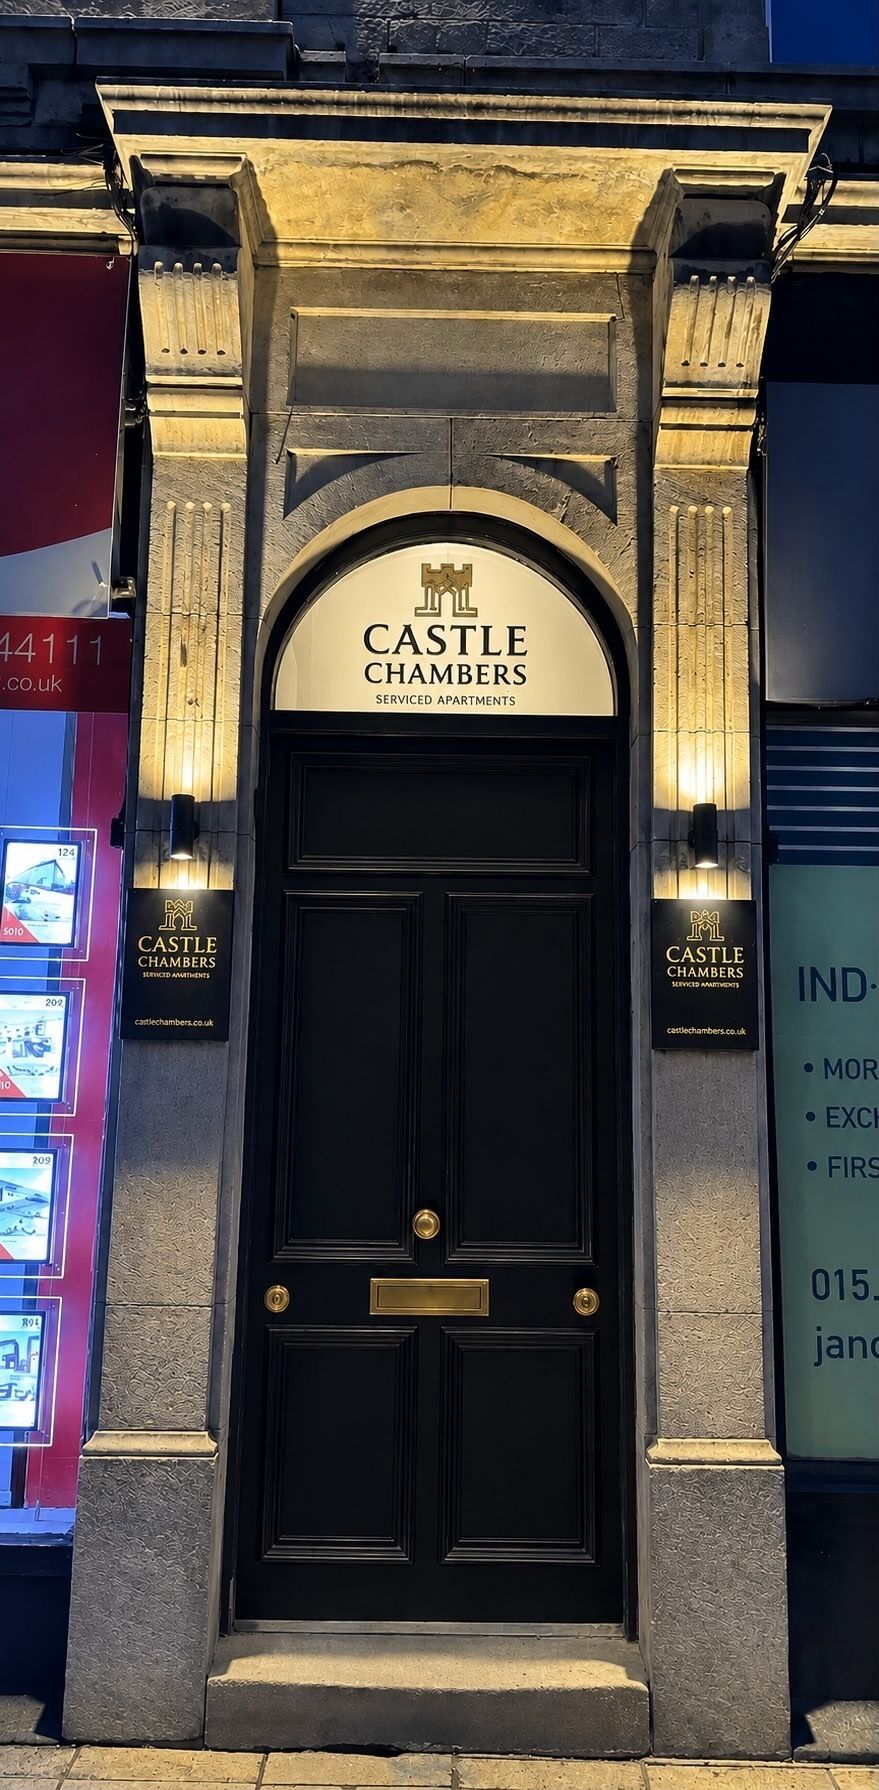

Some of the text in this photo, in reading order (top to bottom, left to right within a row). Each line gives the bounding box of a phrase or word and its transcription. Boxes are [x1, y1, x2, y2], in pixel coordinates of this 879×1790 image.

[363, 623, 528, 656] CASTLE
[364, 662, 527, 686] CHAMBERS
[376, 694, 516, 706] SERVICED APARTMENTS
[58, 847, 75, 857] 124
[137, 935, 218, 954] CASTLE
[665, 946, 744, 964] CASTLE
[138, 956, 216, 969] CHAMBERS
[667, 966, 744, 979] CHAMBERS
[134, 1018, 214, 1027] castlechambers.co.uk
[667, 1027, 746, 1036] castlechambers.co.uk
